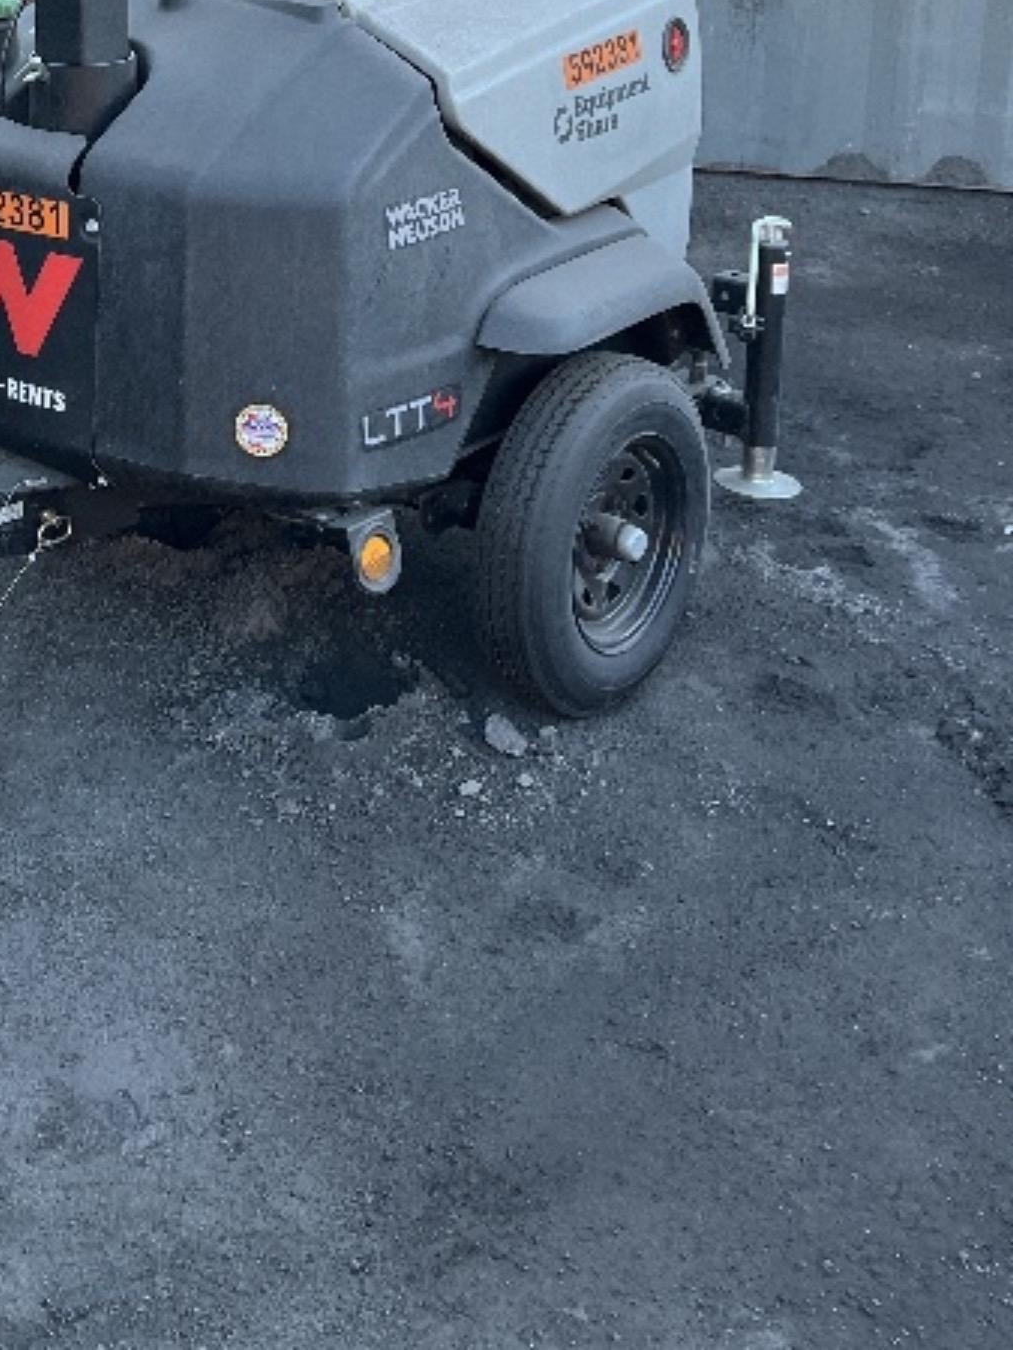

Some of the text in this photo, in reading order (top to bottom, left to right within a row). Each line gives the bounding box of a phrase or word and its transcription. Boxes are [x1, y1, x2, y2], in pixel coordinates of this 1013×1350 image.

[385, 187, 462, 228] WACKER
[388, 205, 466, 251] NEUSON
[361, 390, 458, 447] LTT4
